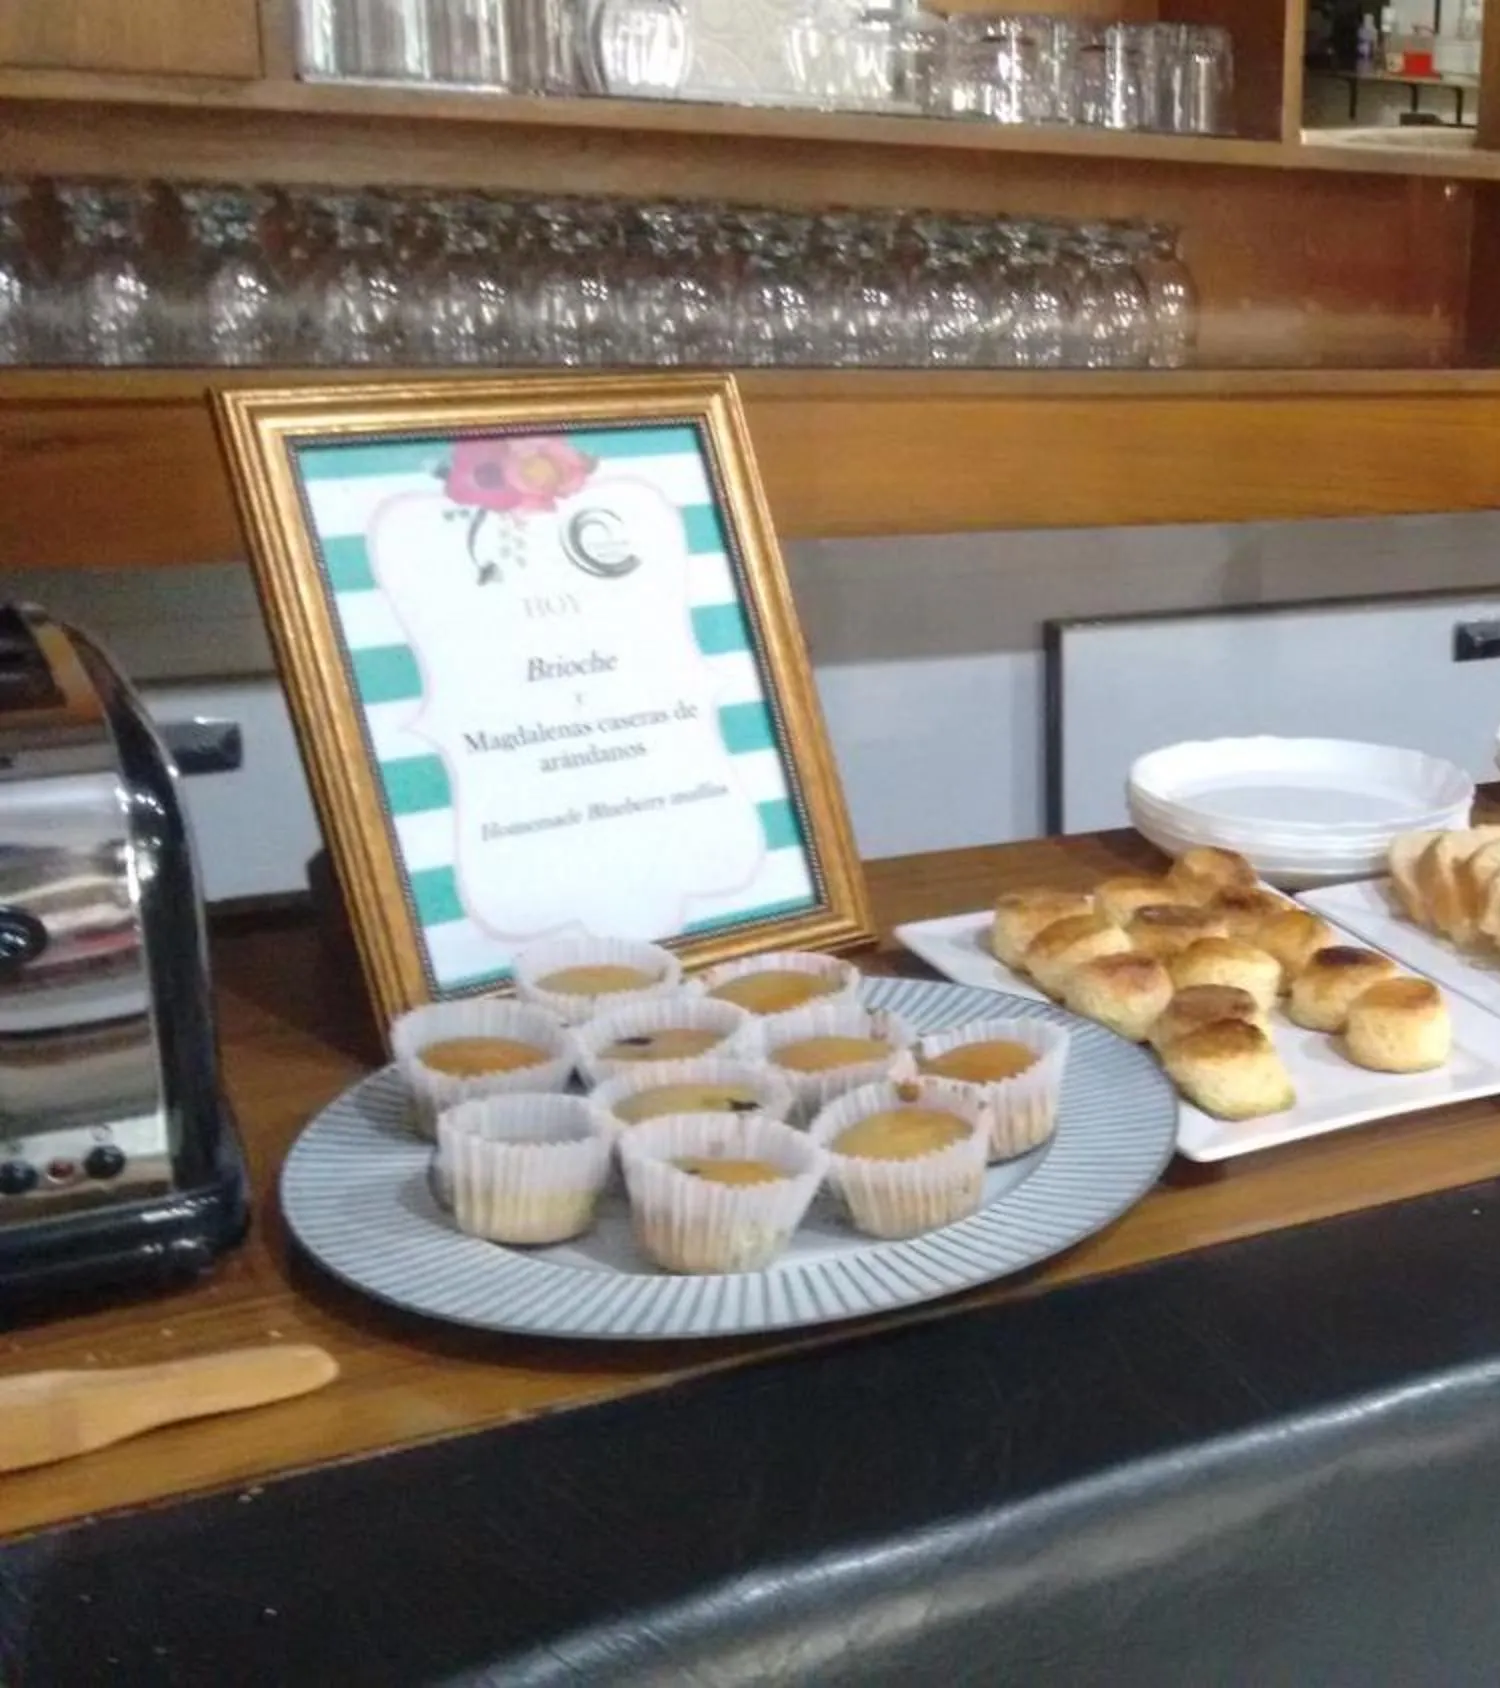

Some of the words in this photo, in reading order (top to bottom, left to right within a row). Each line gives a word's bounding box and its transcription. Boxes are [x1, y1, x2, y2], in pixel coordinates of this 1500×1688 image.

[523, 593, 581, 619] HOY
[527, 649, 619, 682] Brioche
[462, 722, 593, 754] Magdalenas
[597, 709, 669, 734] caseras
[673, 699, 699, 722] de
[539, 741, 648, 774] arándanos
